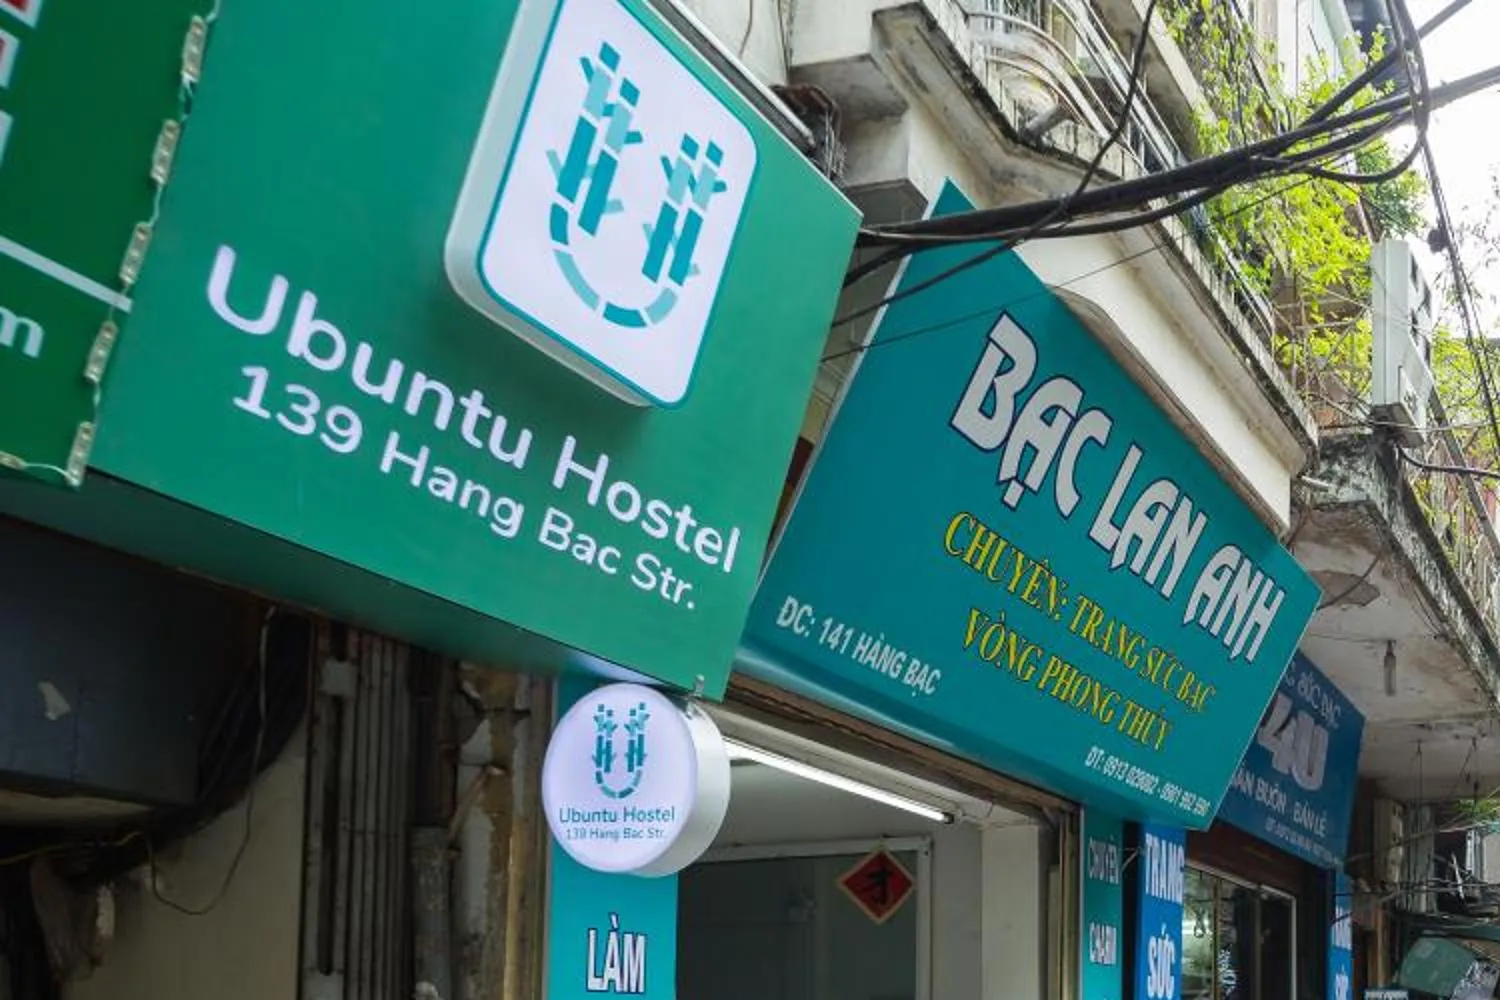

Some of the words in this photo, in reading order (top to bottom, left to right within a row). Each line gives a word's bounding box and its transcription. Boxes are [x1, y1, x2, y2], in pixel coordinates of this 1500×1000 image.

[206, 245, 532, 469] Ubuntu
[553, 435, 740, 573] Hostel
[233, 366, 362, 453] 139
[380, 431, 525, 537] Hang
[538, 507, 621, 573] Bac
[631, 553, 695, 609] Str.
[951, 311, 1113, 519] BẠC
[1089, 442, 1208, 600] LAN
[1183, 544, 1287, 663] ANH
[944, 511, 1068, 621] CHUYÊN:
[1069, 594, 1145, 670] TRANG
[775, 595, 816, 637] ĐC:
[818, 617, 854, 655] 141
[851, 632, 907, 679] HÀNG
[903, 657, 942, 697] BẠC
[962, 607, 1044, 683] VÒNG
[1036, 655, 1121, 725] PHONG
[559, 806, 617, 823] Ubuntu
[623, 805, 675, 823] Hostel
[590, 827, 619, 843] Hang
[623, 827, 644, 839] Bac
[1145, 832, 1185, 904] TRANG
[586, 912, 647, 994] LÀM
[1147, 923, 1176, 1000] SỨC
